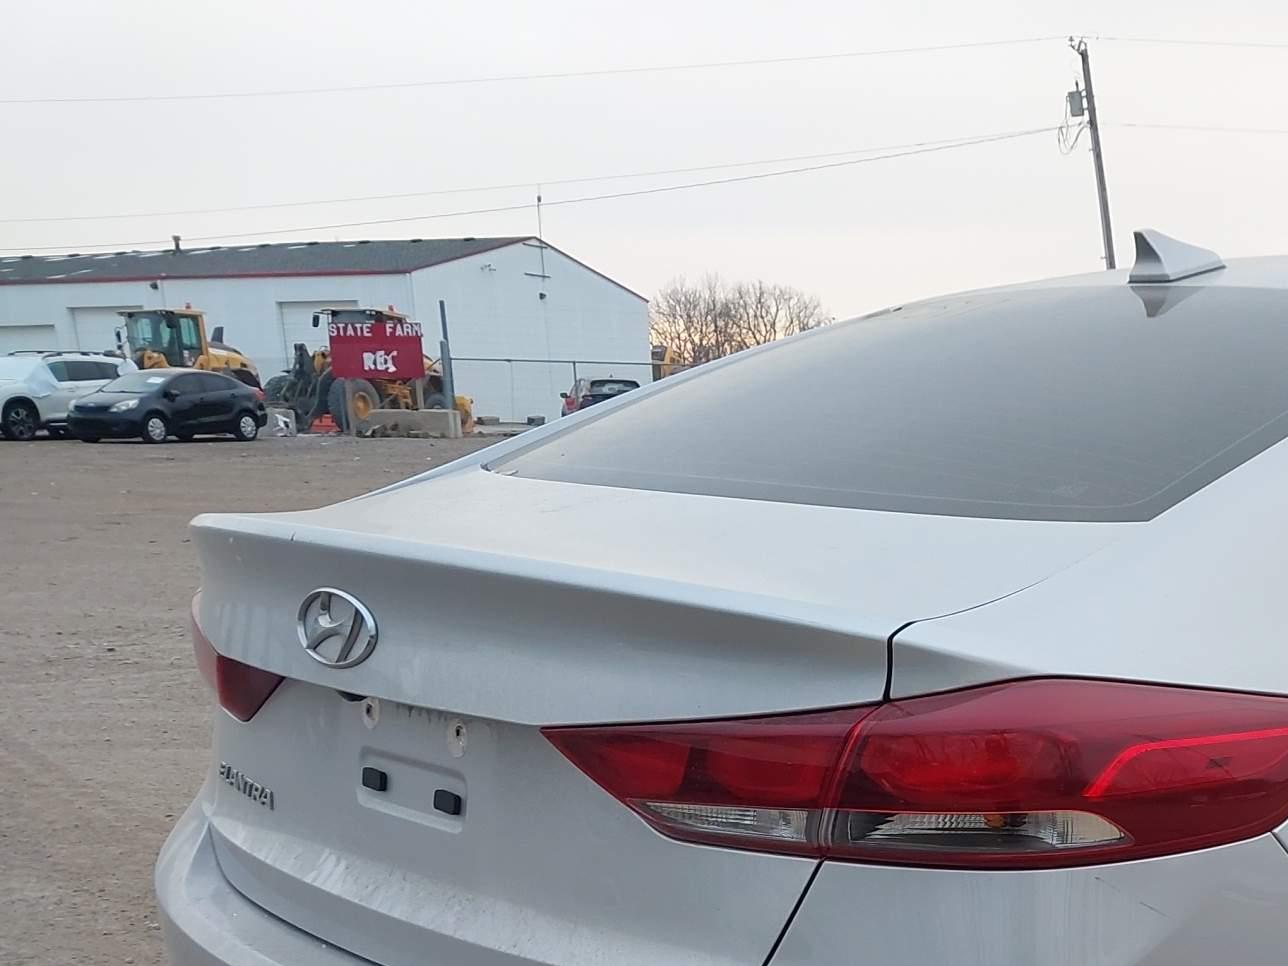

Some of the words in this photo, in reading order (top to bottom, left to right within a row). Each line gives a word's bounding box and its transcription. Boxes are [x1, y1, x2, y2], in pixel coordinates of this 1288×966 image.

[328, 323, 373, 337] STATE
[385, 323, 421, 337] FARM
[219, 760, 275, 811] ELANTRA
